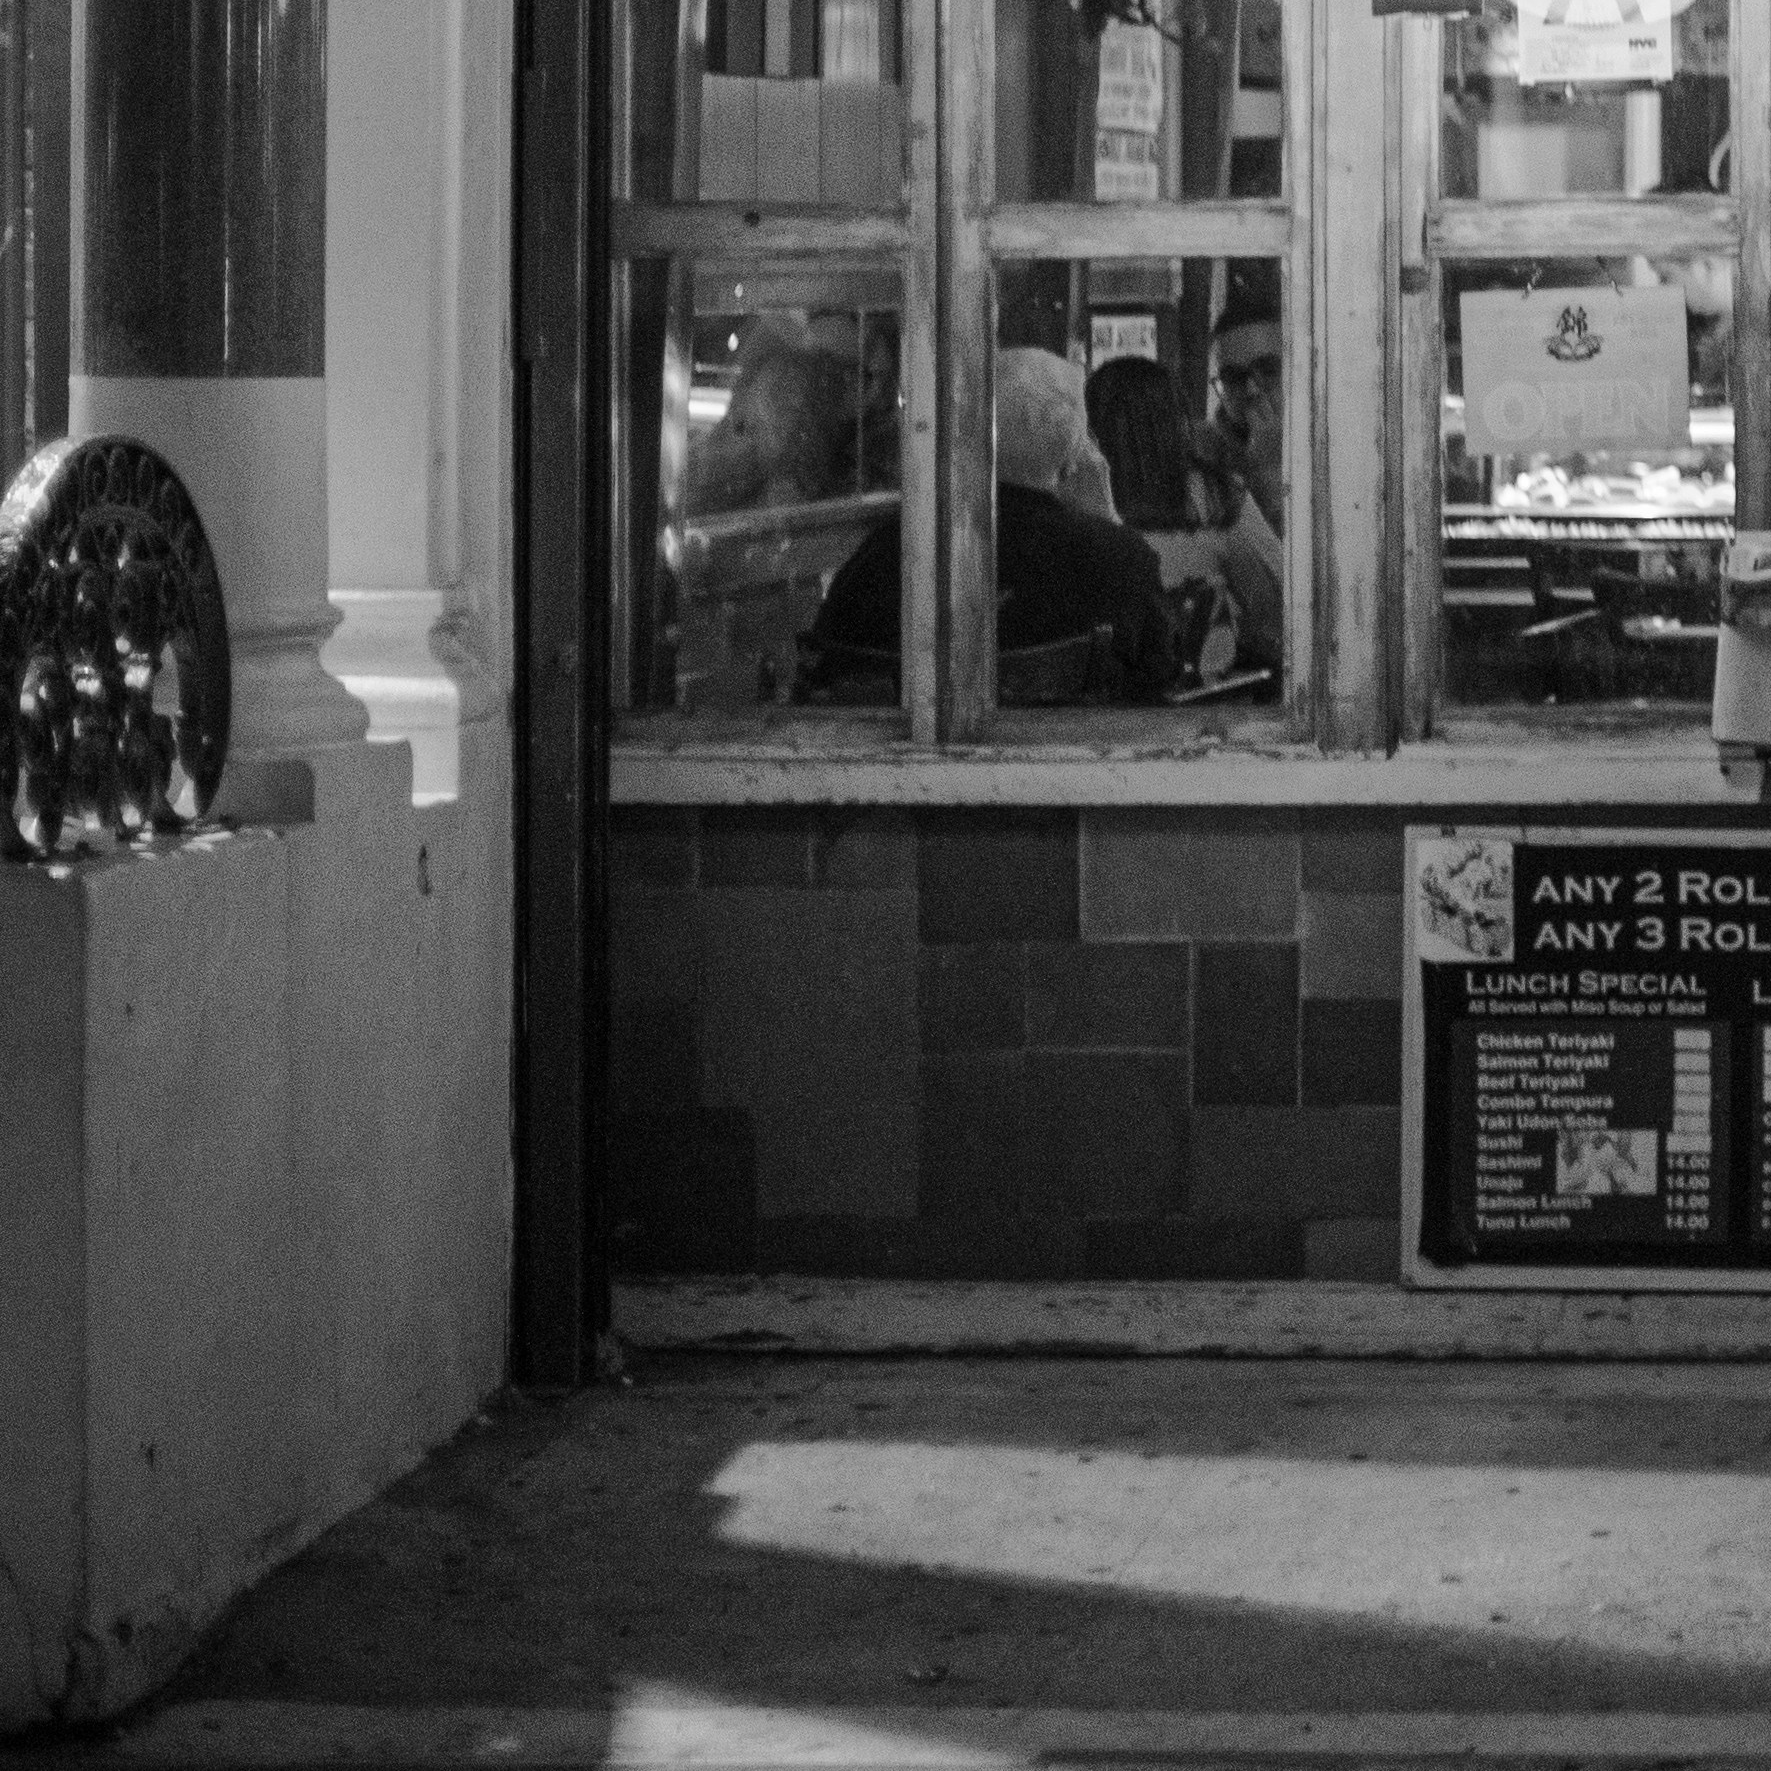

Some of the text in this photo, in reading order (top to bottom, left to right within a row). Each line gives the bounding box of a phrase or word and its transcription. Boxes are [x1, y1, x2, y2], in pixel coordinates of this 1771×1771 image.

[1483, 378, 1671, 441] OPEN
[1533, 875, 1621, 904] ANY
[1635, 871, 1665, 904] 2
[1534, 922, 1622, 949] ANY
[1636, 917, 1665, 950] 3
[1466, 970, 1707, 996] LUNCH SPECIAL
[1489, 1000, 1537, 1014] Served
[1540, 1000, 1568, 1014] with
[1572, 1001, 1605, 1015] Miso
[1608, 1001, 1645, 1017] Soup
[1649, 1004, 1663, 1015] or
[1667, 1001, 1707, 1015] Salad
[1476, 1033, 1615, 1052] Chicken Teriyaki
[1476, 1054, 1610, 1072] Salmon Teriyaki
[1476, 1074, 1586, 1092] Beef Teriyaki
[1476, 1094, 1614, 1112] Combo Tempura
[1476, 1114, 1513, 1130] Yaki
[1517, 1114, 1560, 1130] Udon
[1476, 1134, 1524, 1150] Sushi
[1476, 1154, 1543, 1170] Sashimi
[1476, 1194, 1537, 1209] Salmon
[1541, 1194, 1593, 1209] Lunch
[1476, 1215, 1515, 1229] Tuna
[1520, 1215, 1571, 1231] Lunch
